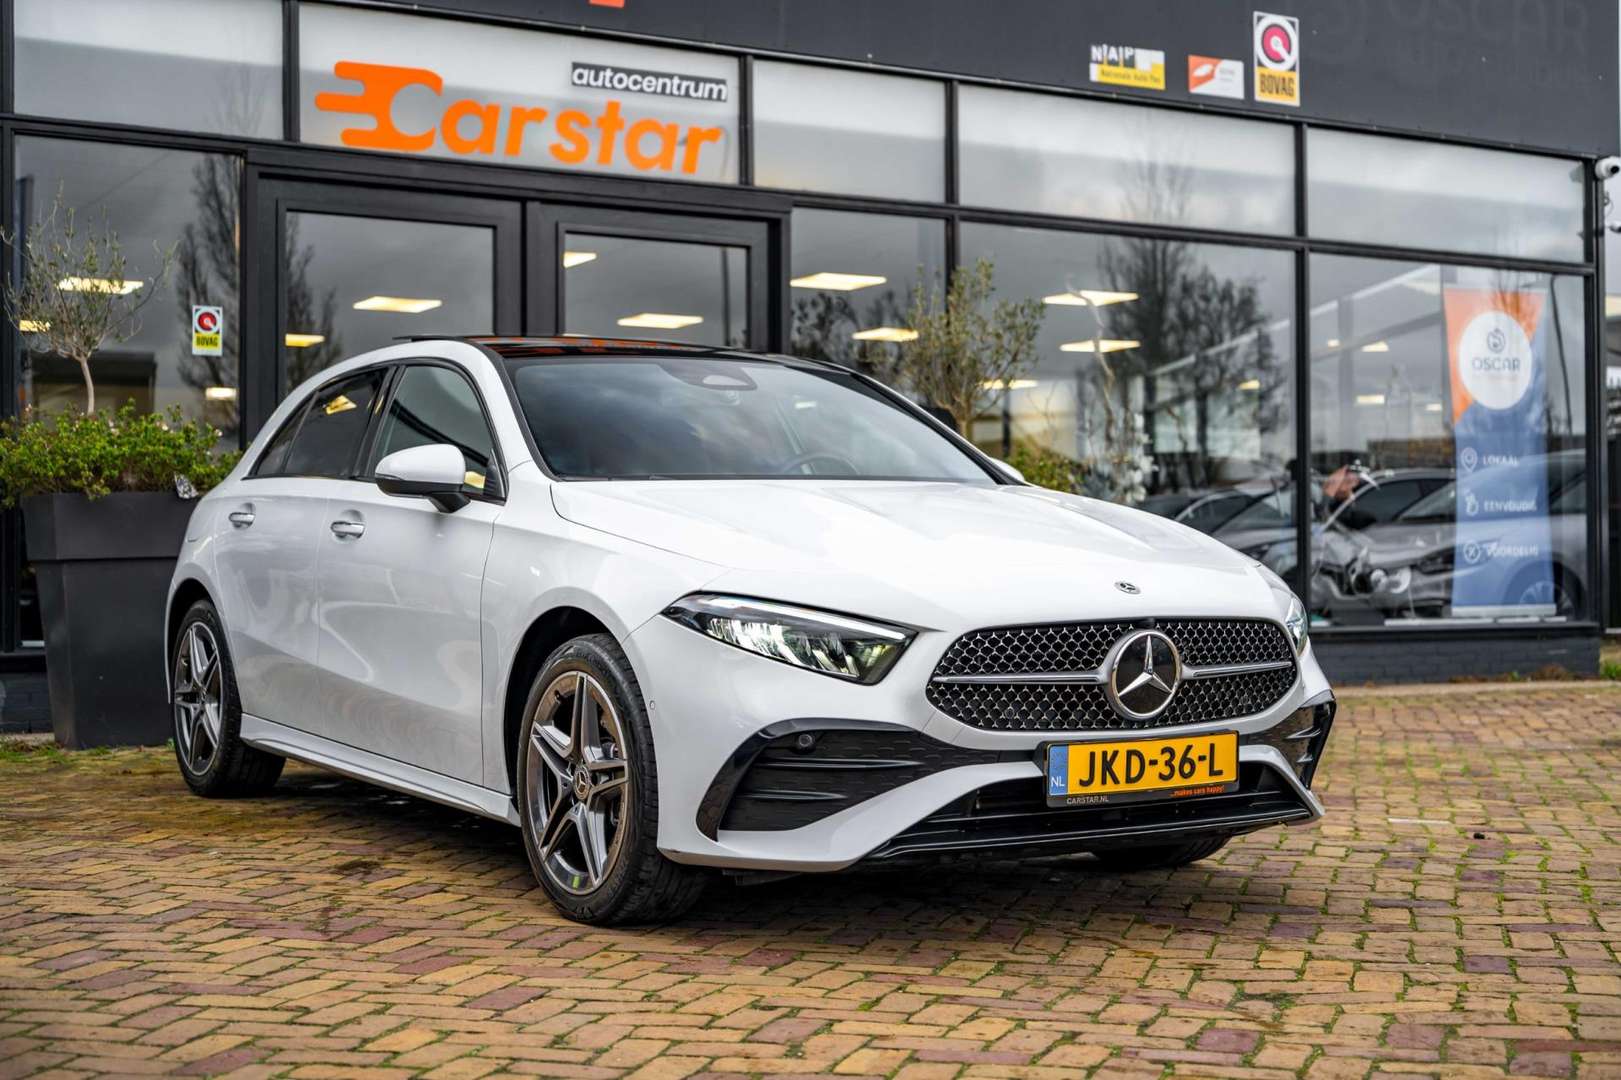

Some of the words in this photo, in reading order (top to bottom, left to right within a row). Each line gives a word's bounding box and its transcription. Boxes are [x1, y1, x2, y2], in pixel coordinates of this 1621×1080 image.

[571, 64, 727, 101] autocentrum
[1260, 74, 1295, 97] BOVAG
[314, 60, 722, 175] Carstar
[196, 336, 218, 347] BOVAG
[1472, 356, 1521, 371] OSCAR
[1483, 455, 1519, 466] LOKAAL
[1079, 743, 1224, 787] JKD-36-L
[1051, 776, 1065, 788] NL
[1066, 795, 1109, 805] CARSTAR.NL
